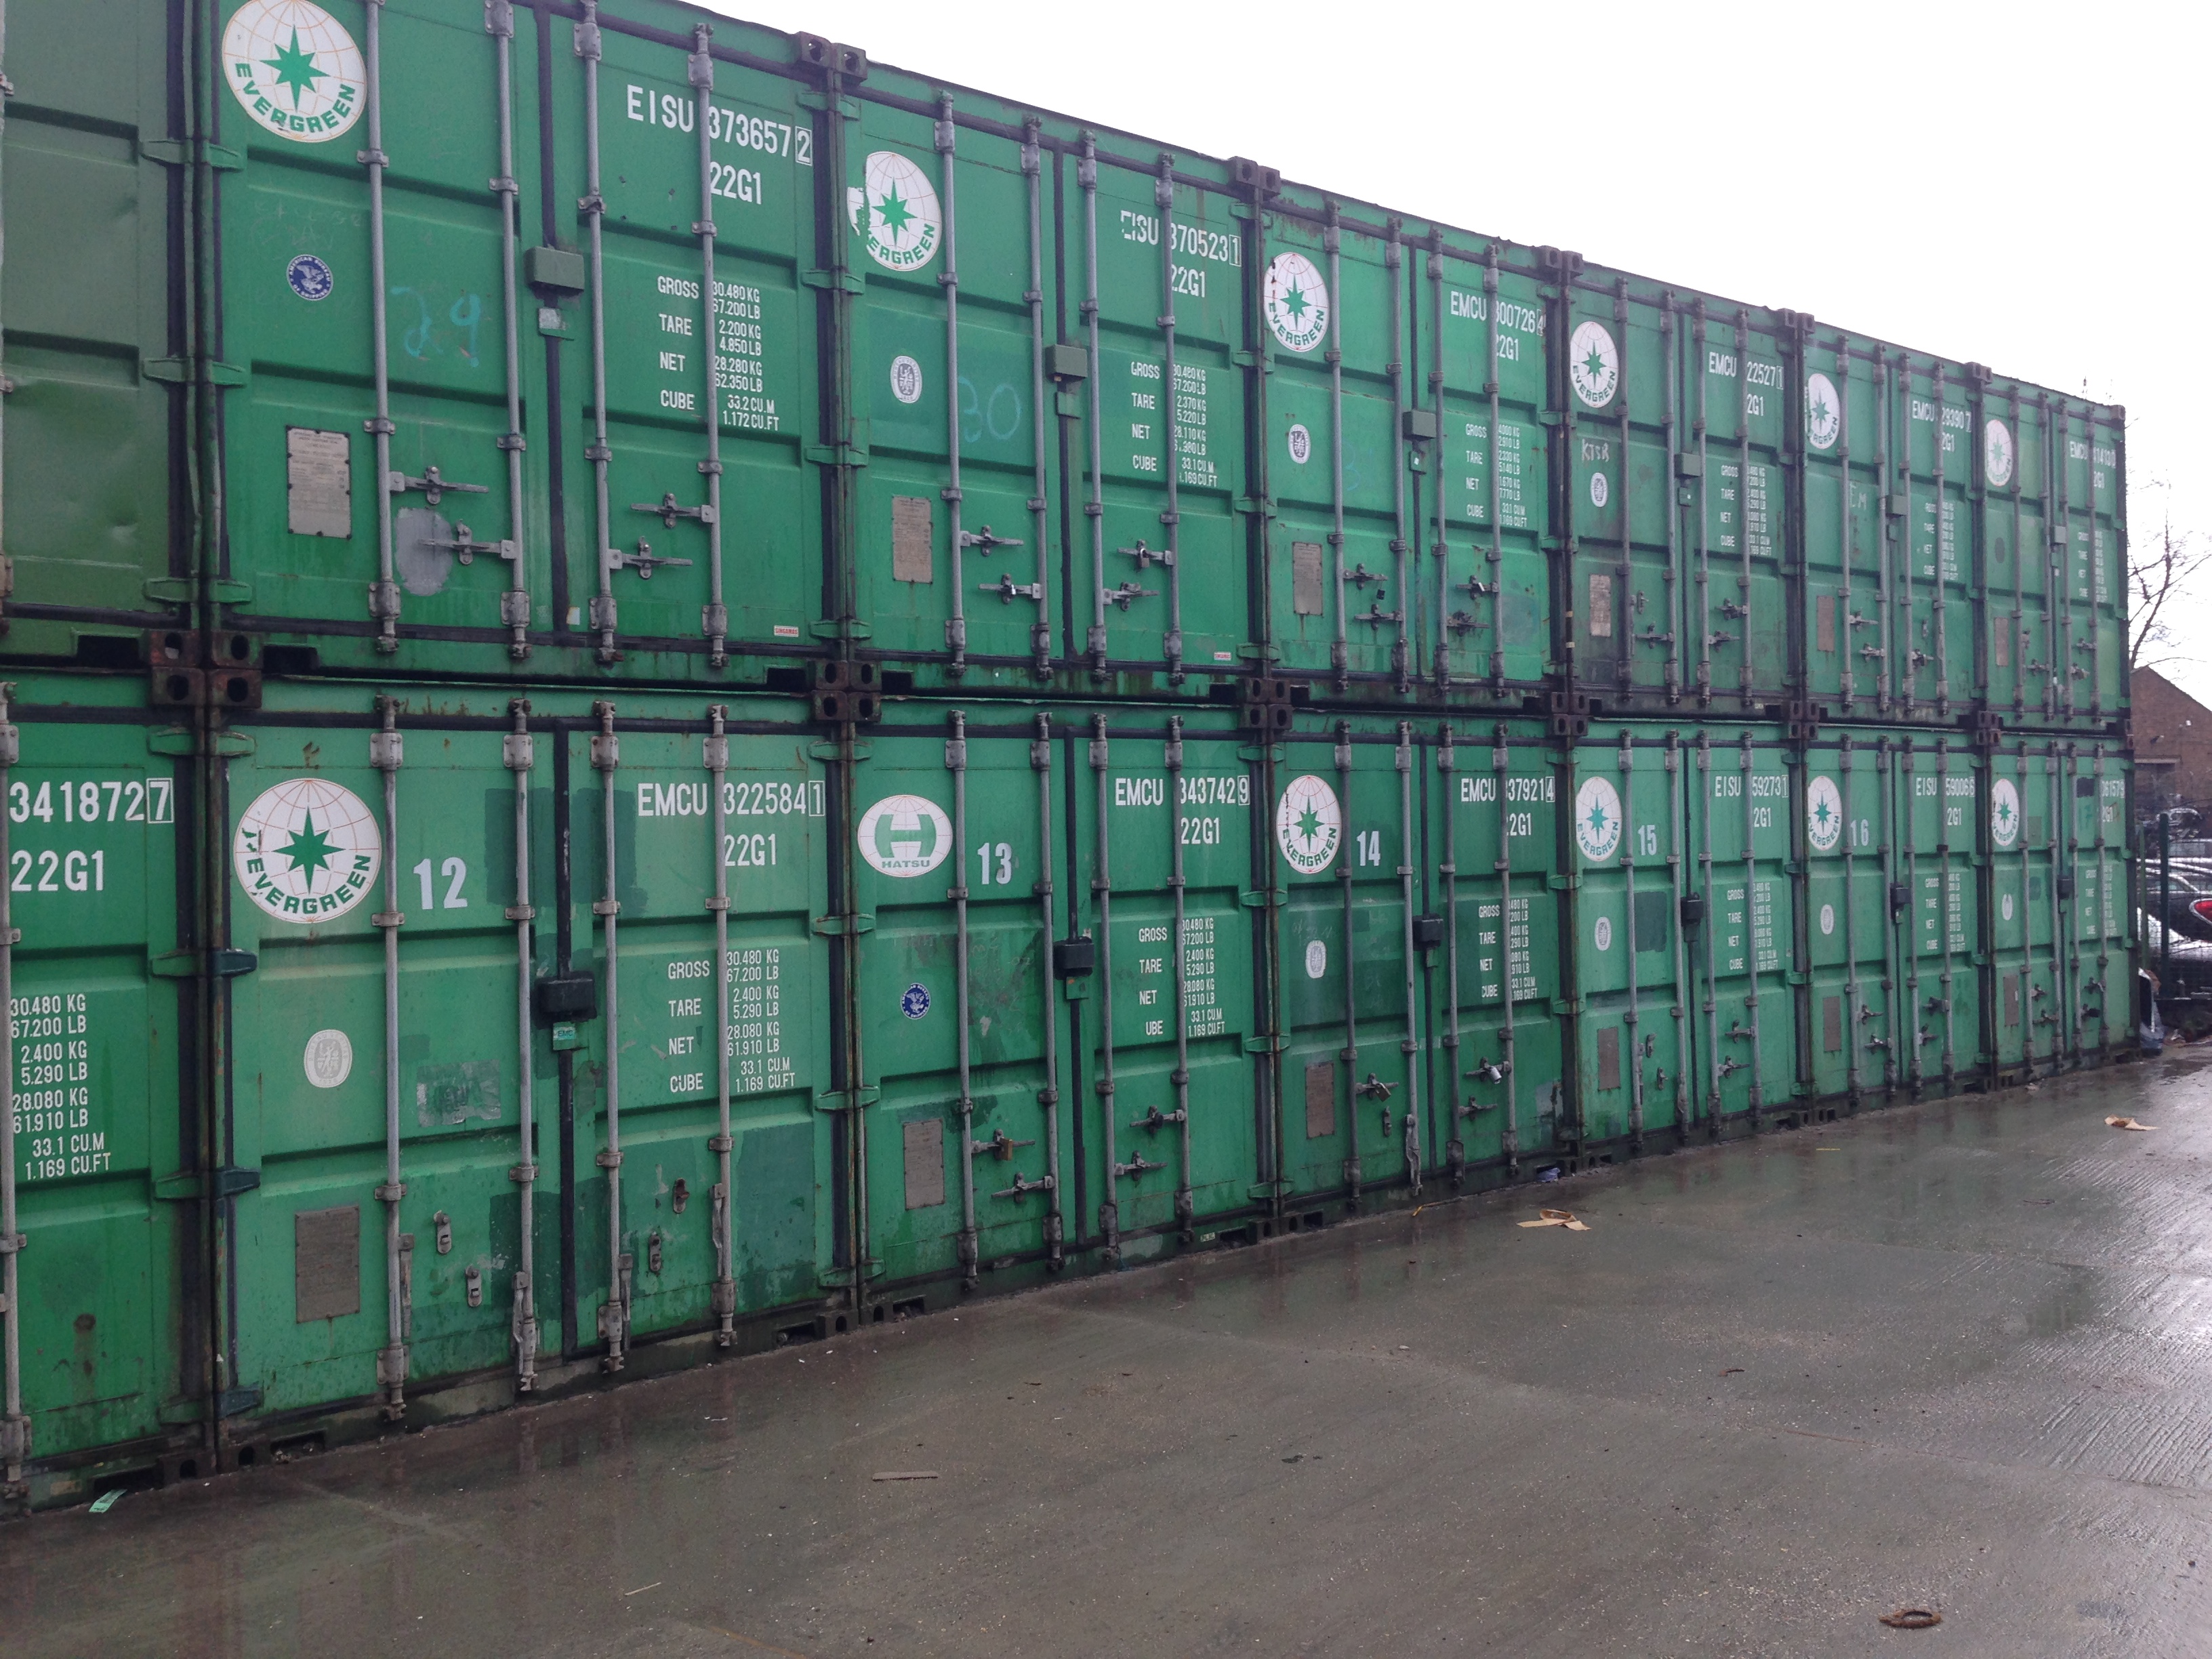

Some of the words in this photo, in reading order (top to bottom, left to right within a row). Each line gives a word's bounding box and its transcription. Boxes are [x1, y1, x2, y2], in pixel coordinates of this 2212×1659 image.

[234, 62, 356, 134] EVERGREEN
[627, 84, 694, 132] EISU
[710, 161, 762, 205] 22G1
[657, 276, 699, 299] GROSS
[712, 281, 745, 300] 30.480
[746, 287, 760, 303] KG
[747, 304, 760, 320] LB
[1450, 291, 1487, 321] EMCU
[659, 313, 692, 336] TARE
[719, 319, 747, 337] 2.200
[749, 325, 761, 340] KG
[1269, 302, 1326, 346] EVERGREEN
[720, 337, 747, 354] 4.850
[749, 342, 762, 356] LB
[1496, 334, 1519, 361] 2G1
[659, 352, 685, 371] NET
[715, 356, 747, 373] 28.280
[749, 361, 762, 376] KG
[1131, 361, 1160, 380] GROSS
[1708, 351, 1737, 377] EMCU
[715, 373, 748, 390] 62.350
[750, 378, 762, 392] LB
[1573, 365, 1616, 402] EVERGREEN
[660, 390, 695, 410] CUBE
[727, 394, 749, 410] 33.2
[750, 398, 775, 414] CU.M
[1131, 392, 1155, 409] TARE
[1197, 399, 1206, 411] KG
[722, 410, 750, 428] 1.172
[751, 414, 779, 431] CU.FT
[1197, 413, 1206, 425] LB
[1466, 424, 1487, 438] GROSS
[1132, 424, 1150, 439] NET
[1197, 430, 1206, 442] KG
[1197, 444, 1206, 455] LB
[1466, 450, 1483, 465] TARE
[1132, 455, 1157, 471] CUBE
[1466, 477, 1479, 491] NET
[1467, 504, 1484, 518] CUBE
[1115, 778, 1164, 806] EMCU
[1461, 778, 1496, 802] EMCU
[1715, 776, 1741, 797] EISU
[638, 783, 708, 817] EMCU
[1181, 817, 1220, 844] 22G1
[1507, 813, 1532, 836] 2G1
[1851, 819, 1869, 846] 16
[724, 834, 777, 866] 22G1
[1283, 827, 1337, 867] EVERGREEN
[1356, 830, 1381, 867] 14
[1578, 821, 1618, 856] EVERGREEN
[1638, 825, 1658, 856] 15
[11, 850, 104, 891] 22G1
[882, 859, 930, 869] HATSU
[977, 842, 1012, 884] 13
[247, 854, 371, 914] EVERGREEN
[413, 857, 468, 910] 12
[1479, 905, 1500, 918] GROSS
[1139, 927, 1167, 943] GROSS
[1205, 918, 1214, 930] KG
[1206, 932, 1214, 944] LB
[1479, 932, 1496, 945] TARE
[668, 960, 710, 979] GROSS
[726, 950, 762, 966] 30.480
[766, 949, 779, 964] KG
[1139, 958, 1162, 973] TARE
[1206, 948, 1214, 960] KG
[1206, 962, 1214, 974] LB
[1479, 958, 1493, 972] NET
[726, 966, 762, 983] 67.200
[766, 966, 779, 980] LB
[668, 998, 702, 1017] TARE
[733, 986, 762, 1003] 2.400
[766, 985, 779, 1000] KG
[1139, 989, 1158, 1005] NET
[1206, 978, 1214, 991] KG
[1206, 992, 1215, 1004] LB
[10, 995, 61, 1017] 30.480
[67, 994, 86, 1012] KG
[733, 1003, 762, 1019] 5.290
[766, 1002, 779, 1017] LB
[11, 1017, 62, 1038] 67.200
[68, 1015, 87, 1033] LB
[669, 1036, 694, 1055] NET
[727, 1023, 762, 1040] 28.080
[766, 1021, 779, 1036] KG
[21, 1042, 62, 1064] 2.400
[68, 1040, 87, 1059] KG
[728, 1040, 762, 1057] 61.910
[767, 1038, 779, 1052] LB
[21, 1064, 63, 1085] 5.290
[69, 1062, 87, 1081] LB
[670, 1073, 703, 1092] CUBE
[741, 1060, 762, 1075] 33.1
[767, 1057, 790, 1073] CU.M
[735, 1077, 763, 1092] 1.169
[768, 1073, 795, 1089] CU.FT
[12, 1089, 64, 1113] 28.080
[70, 1087, 88, 1106] KG
[13, 1111, 64, 1134] 61.910
[70, 1109, 88, 1128] LB
[33, 1136, 64, 1158] 33.1
[70, 1132, 104, 1153] CU.M
[26, 1158, 66, 1181] 1.169
[71, 1153, 111, 1174] CU.FT
